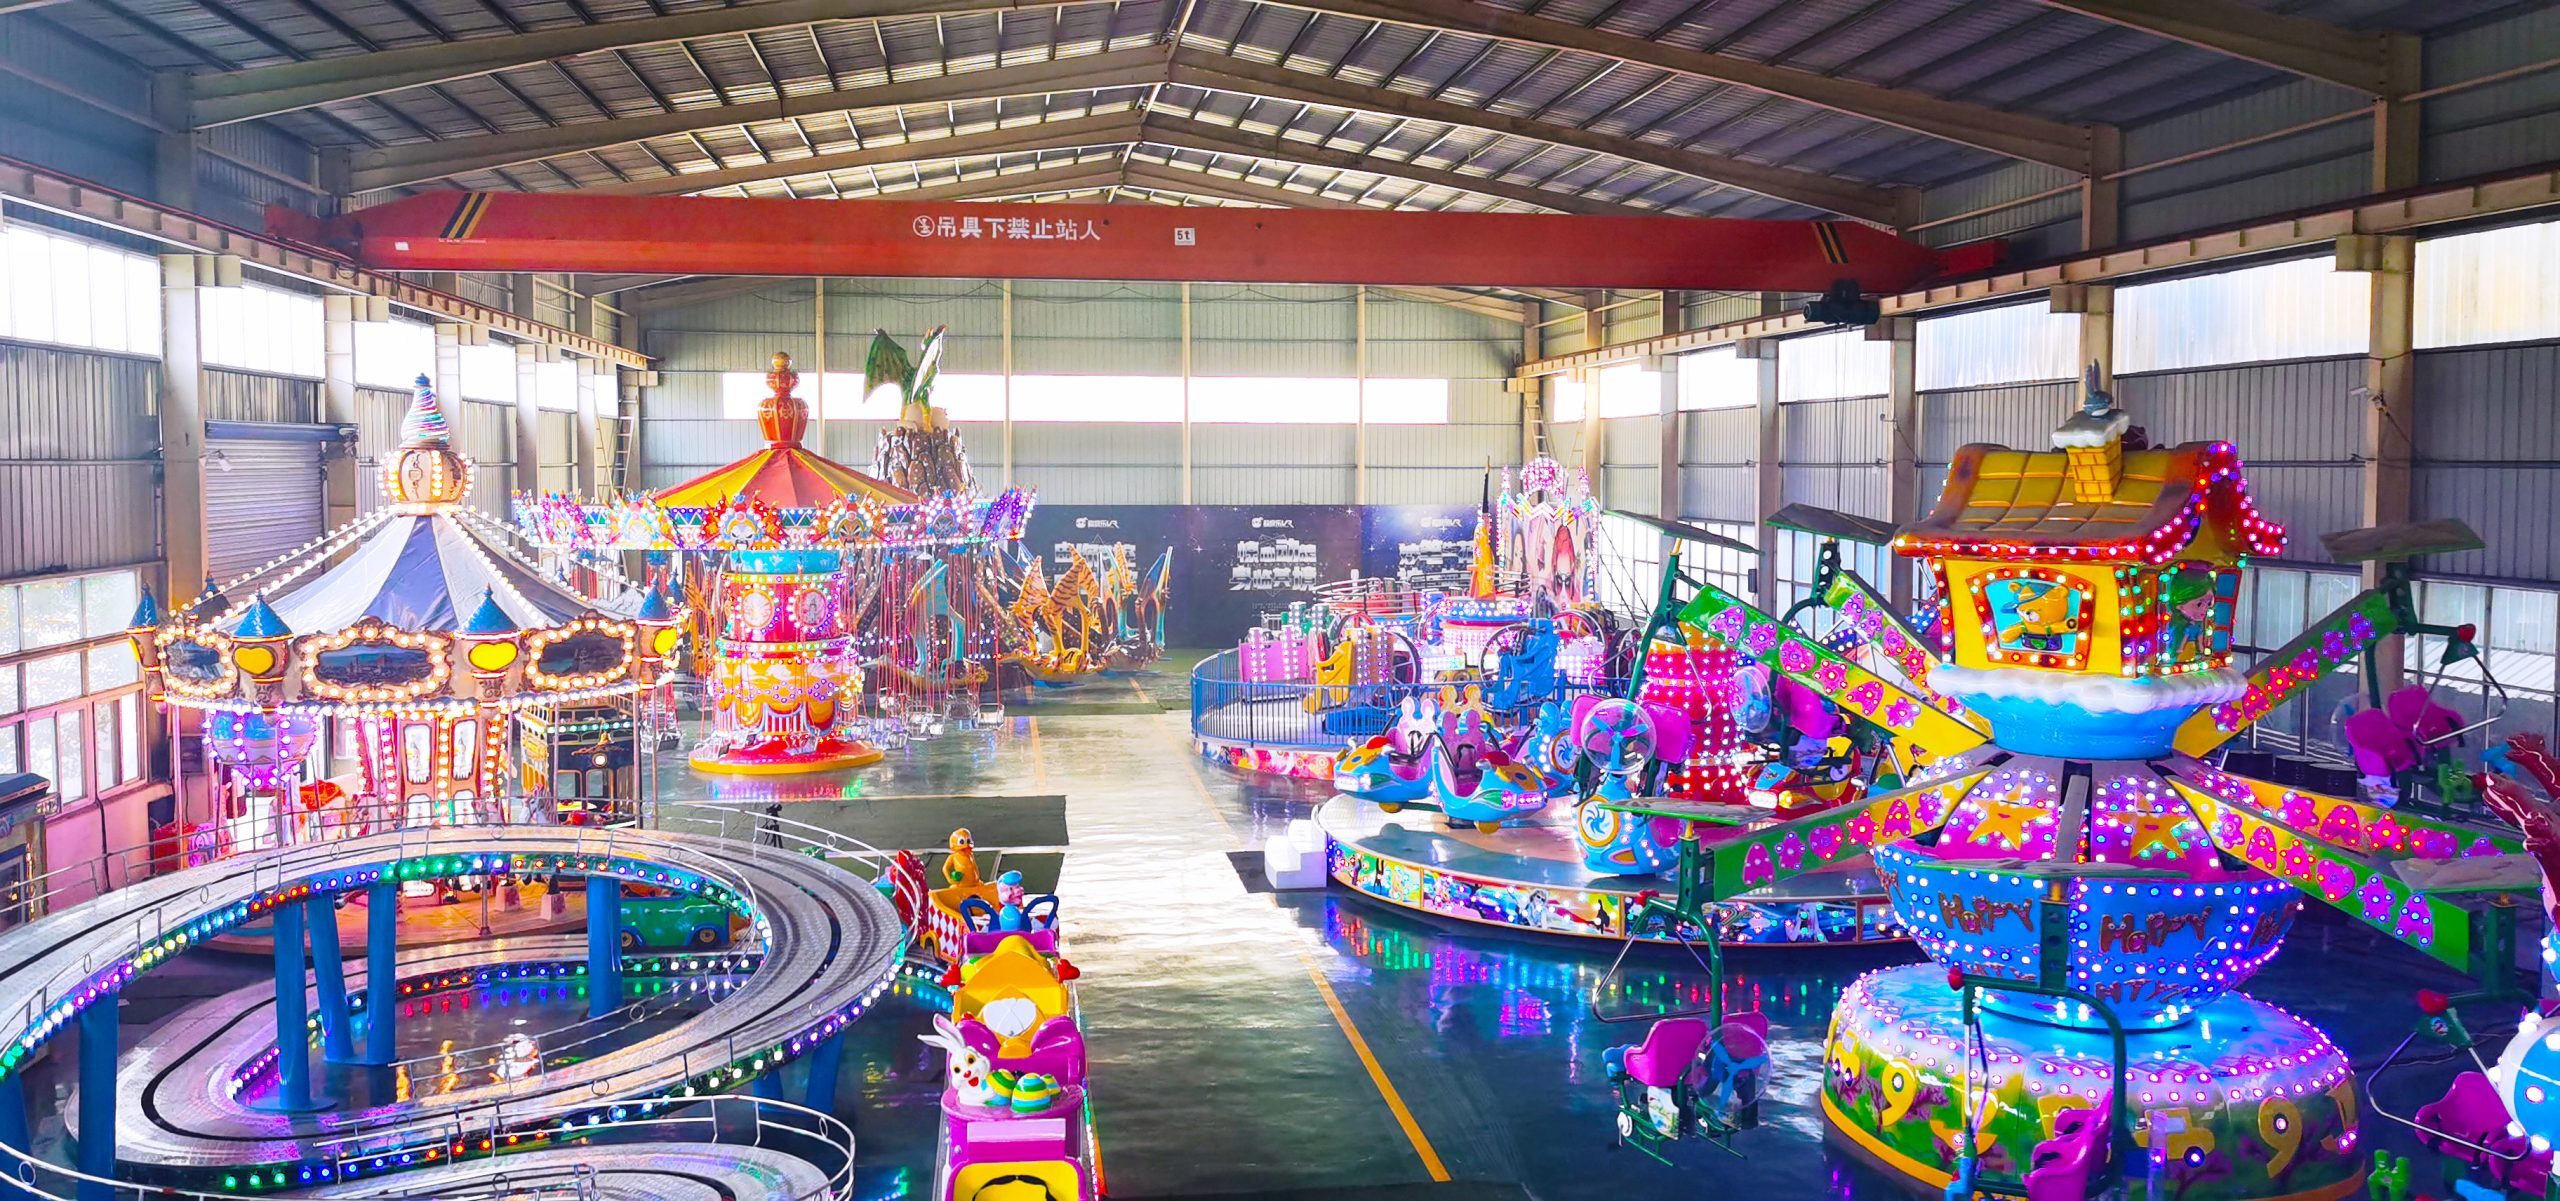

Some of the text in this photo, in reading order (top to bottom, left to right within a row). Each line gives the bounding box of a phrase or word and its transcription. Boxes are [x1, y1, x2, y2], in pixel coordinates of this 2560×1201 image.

[937, 215, 1101, 241] 吊具下禁止站人
